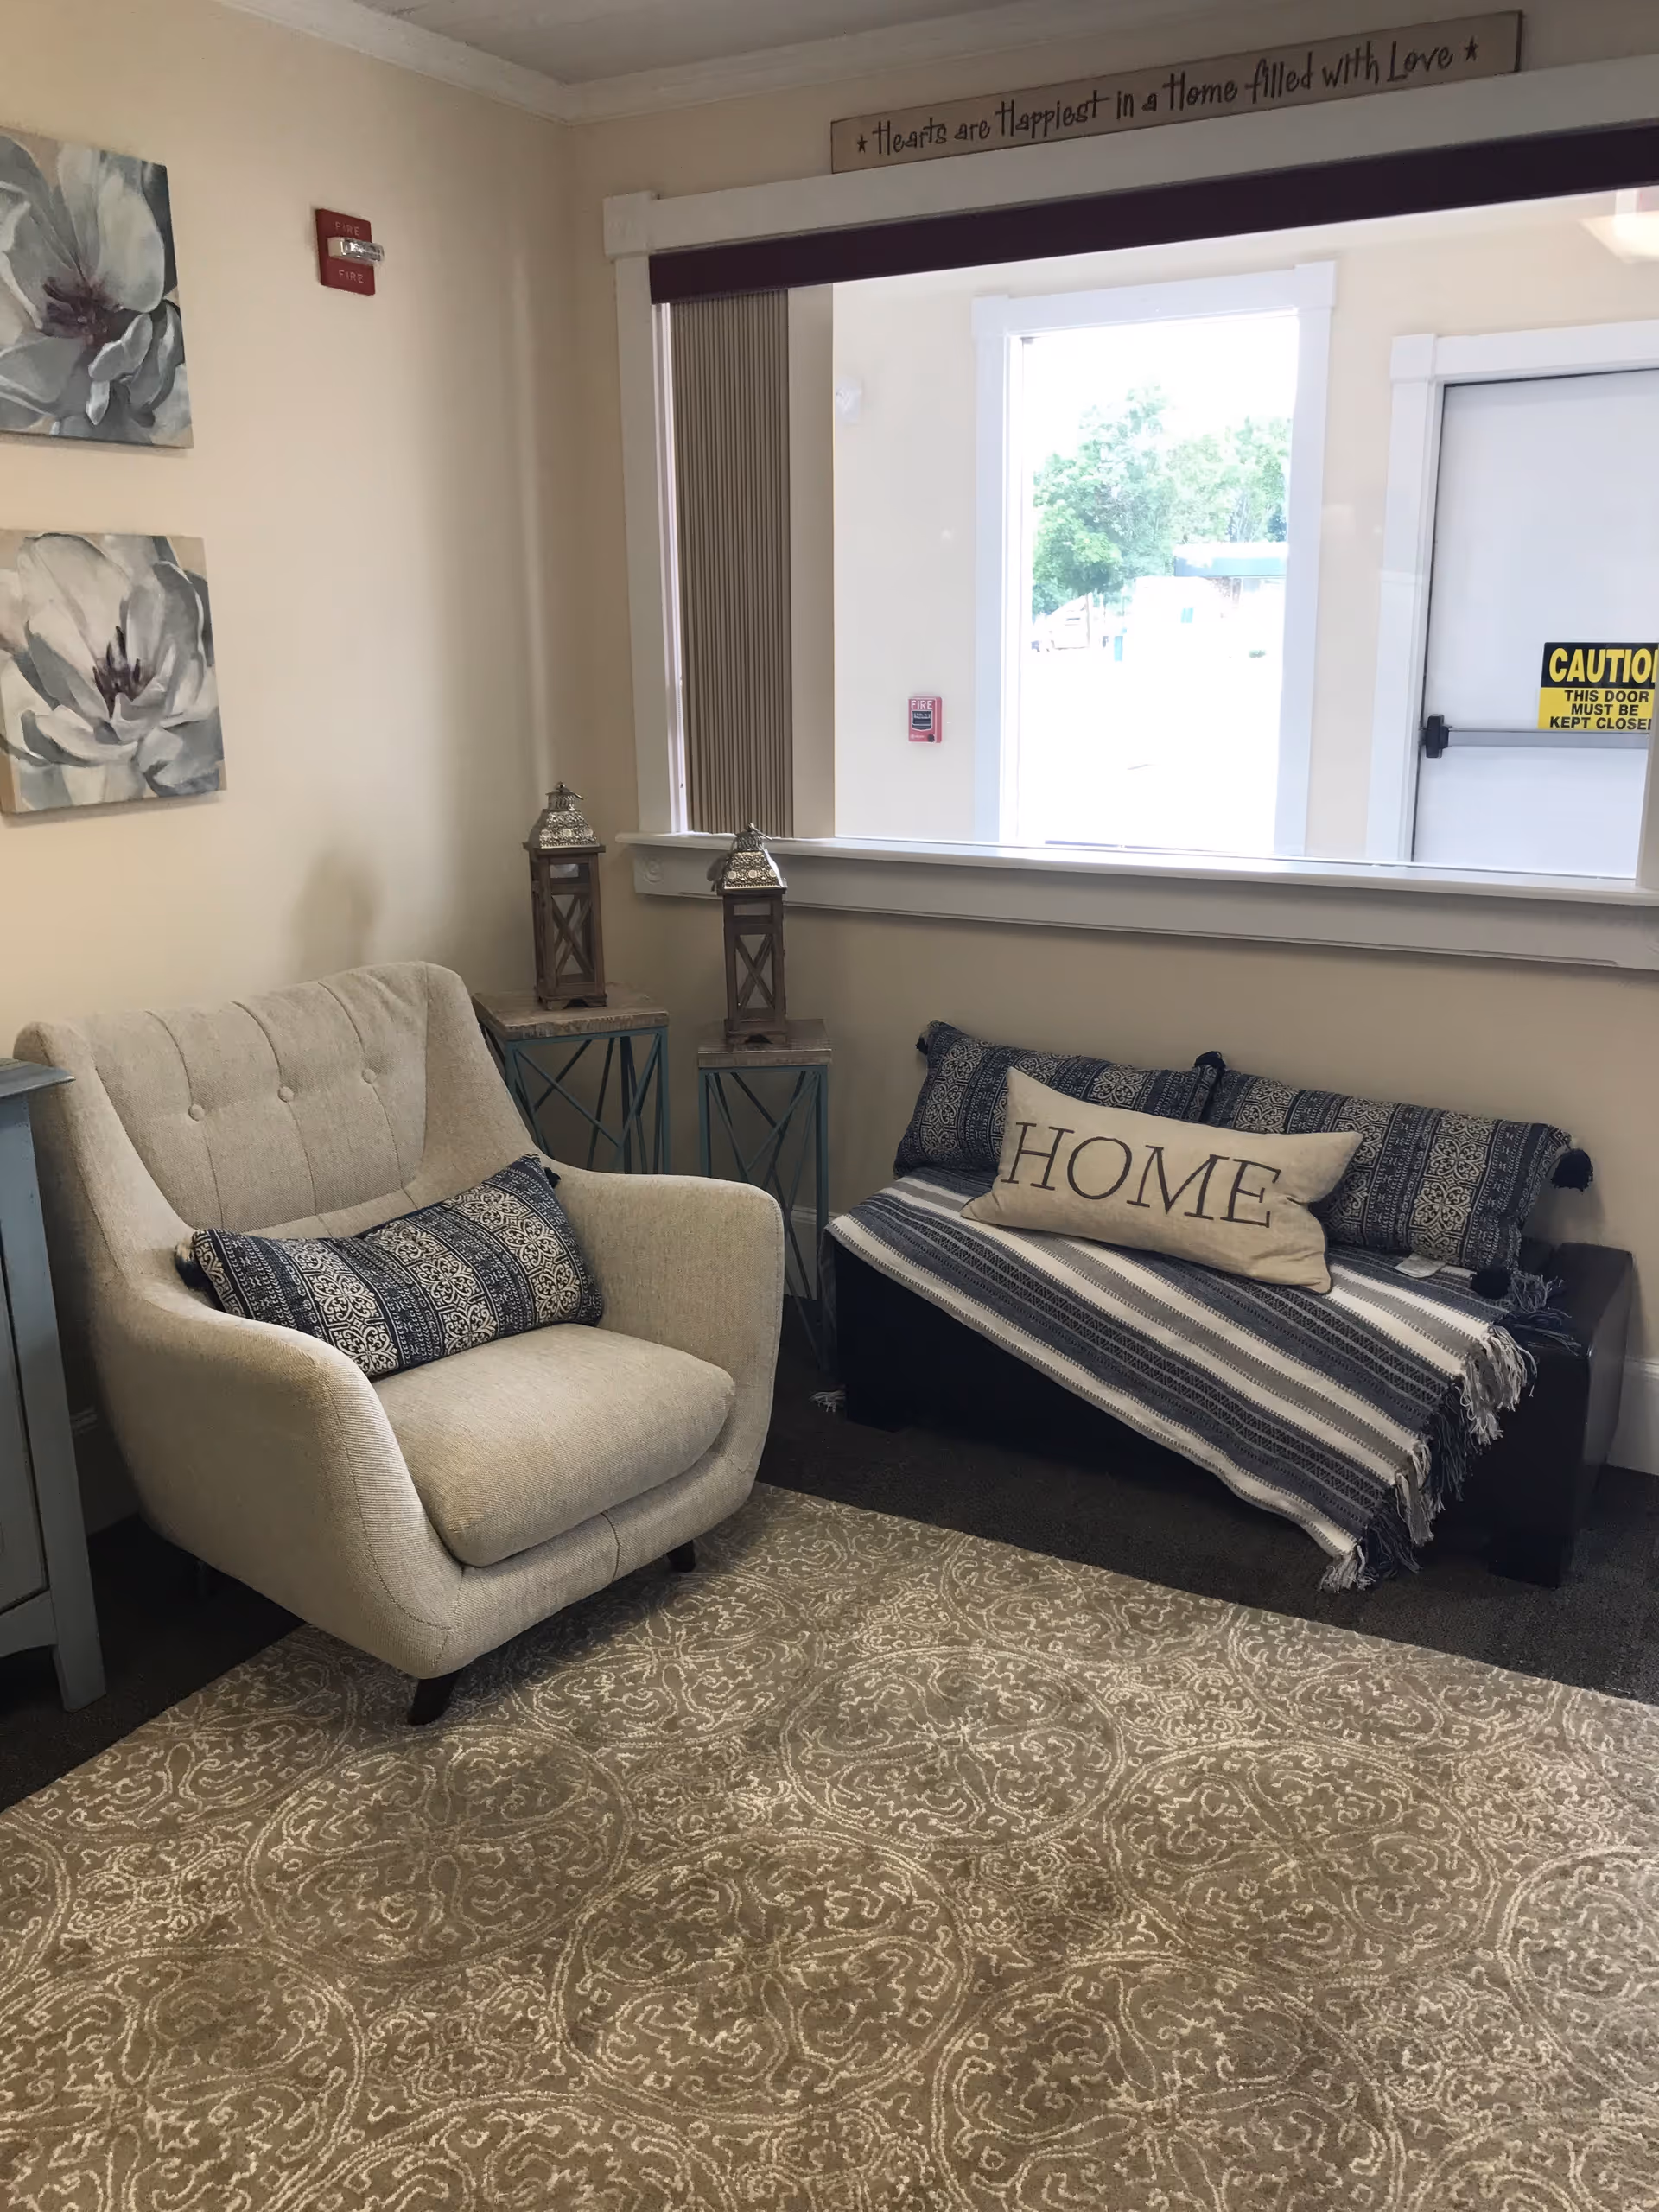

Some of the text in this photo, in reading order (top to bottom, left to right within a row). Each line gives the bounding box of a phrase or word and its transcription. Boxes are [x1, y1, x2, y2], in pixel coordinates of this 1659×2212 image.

[872, 40, 1454, 156] Hearts are Happiest in a Home filled with Love
[334, 221, 360, 236] FIRE
[339, 269, 364, 283] FIRE
[1548, 647, 1657, 683] CAUTIO
[1564, 690, 1649, 703] THIS DOOR
[911, 700, 933, 709] FIRE
[1571, 703, 1639, 716] MUST BE
[1549, 716, 1592, 729] KEPT
[1000, 1122, 1281, 1229] HOME
